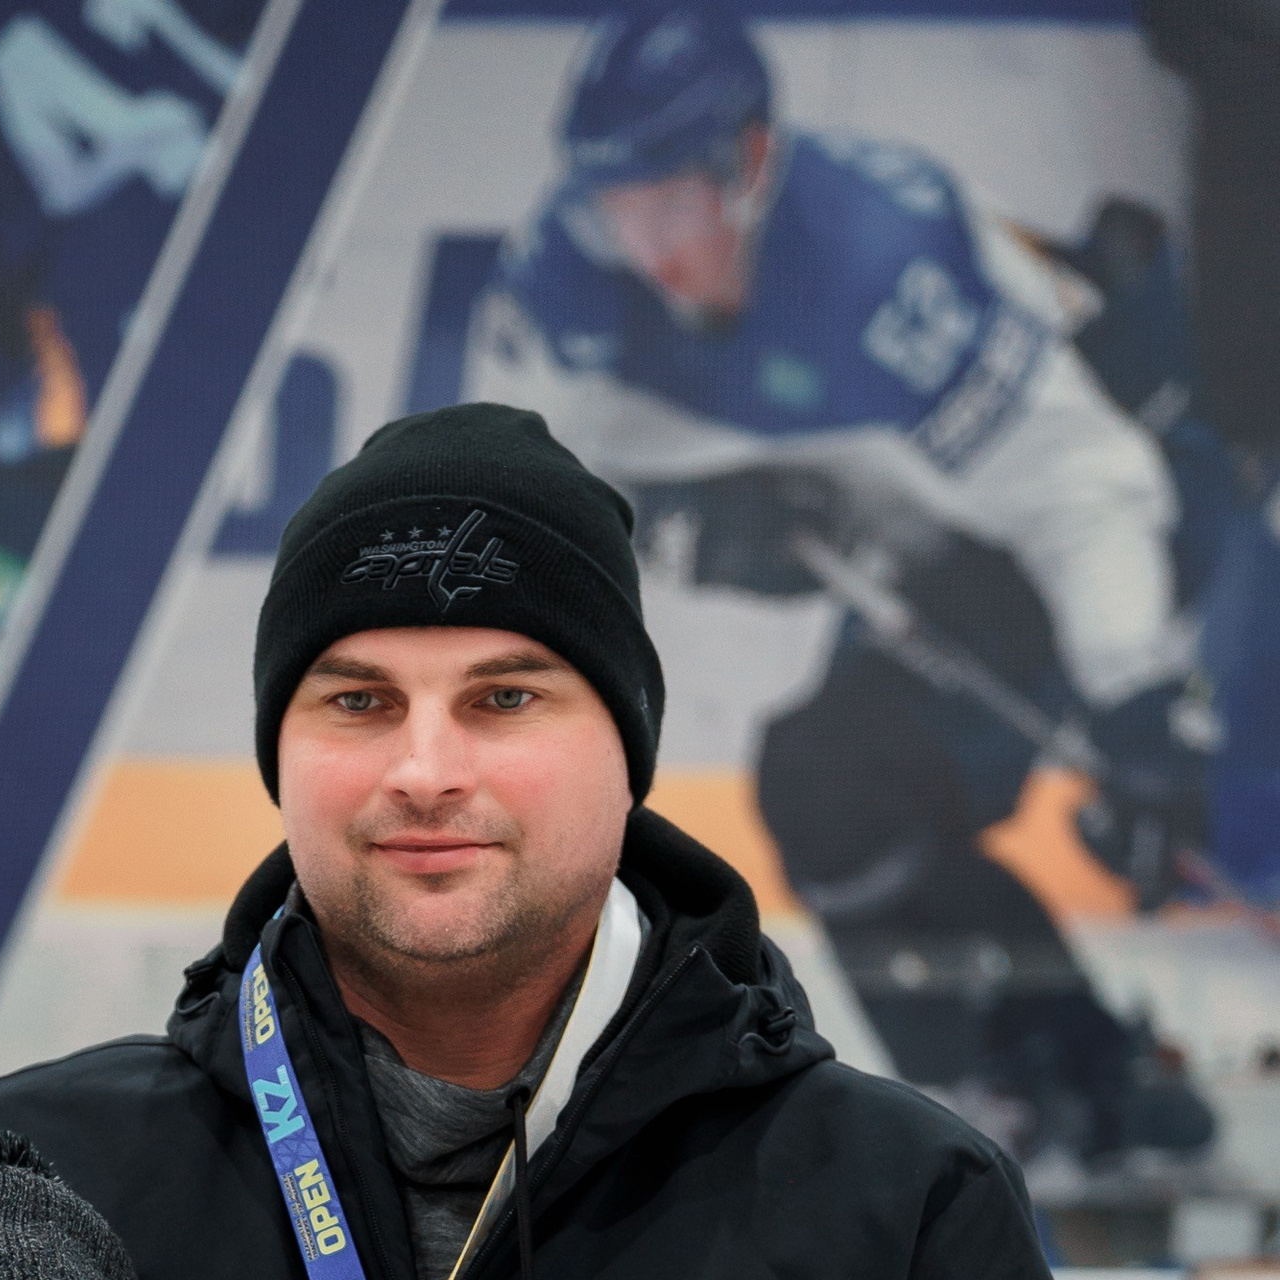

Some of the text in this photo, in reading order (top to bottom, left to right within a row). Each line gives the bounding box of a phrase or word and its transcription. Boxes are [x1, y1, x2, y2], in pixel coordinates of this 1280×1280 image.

[341, 509, 520, 614] capitals
[360, 539, 448, 557] WASHINGTON
[252, 1064, 306, 1144] KZ
[294, 1158, 346, 1256] OPEN
